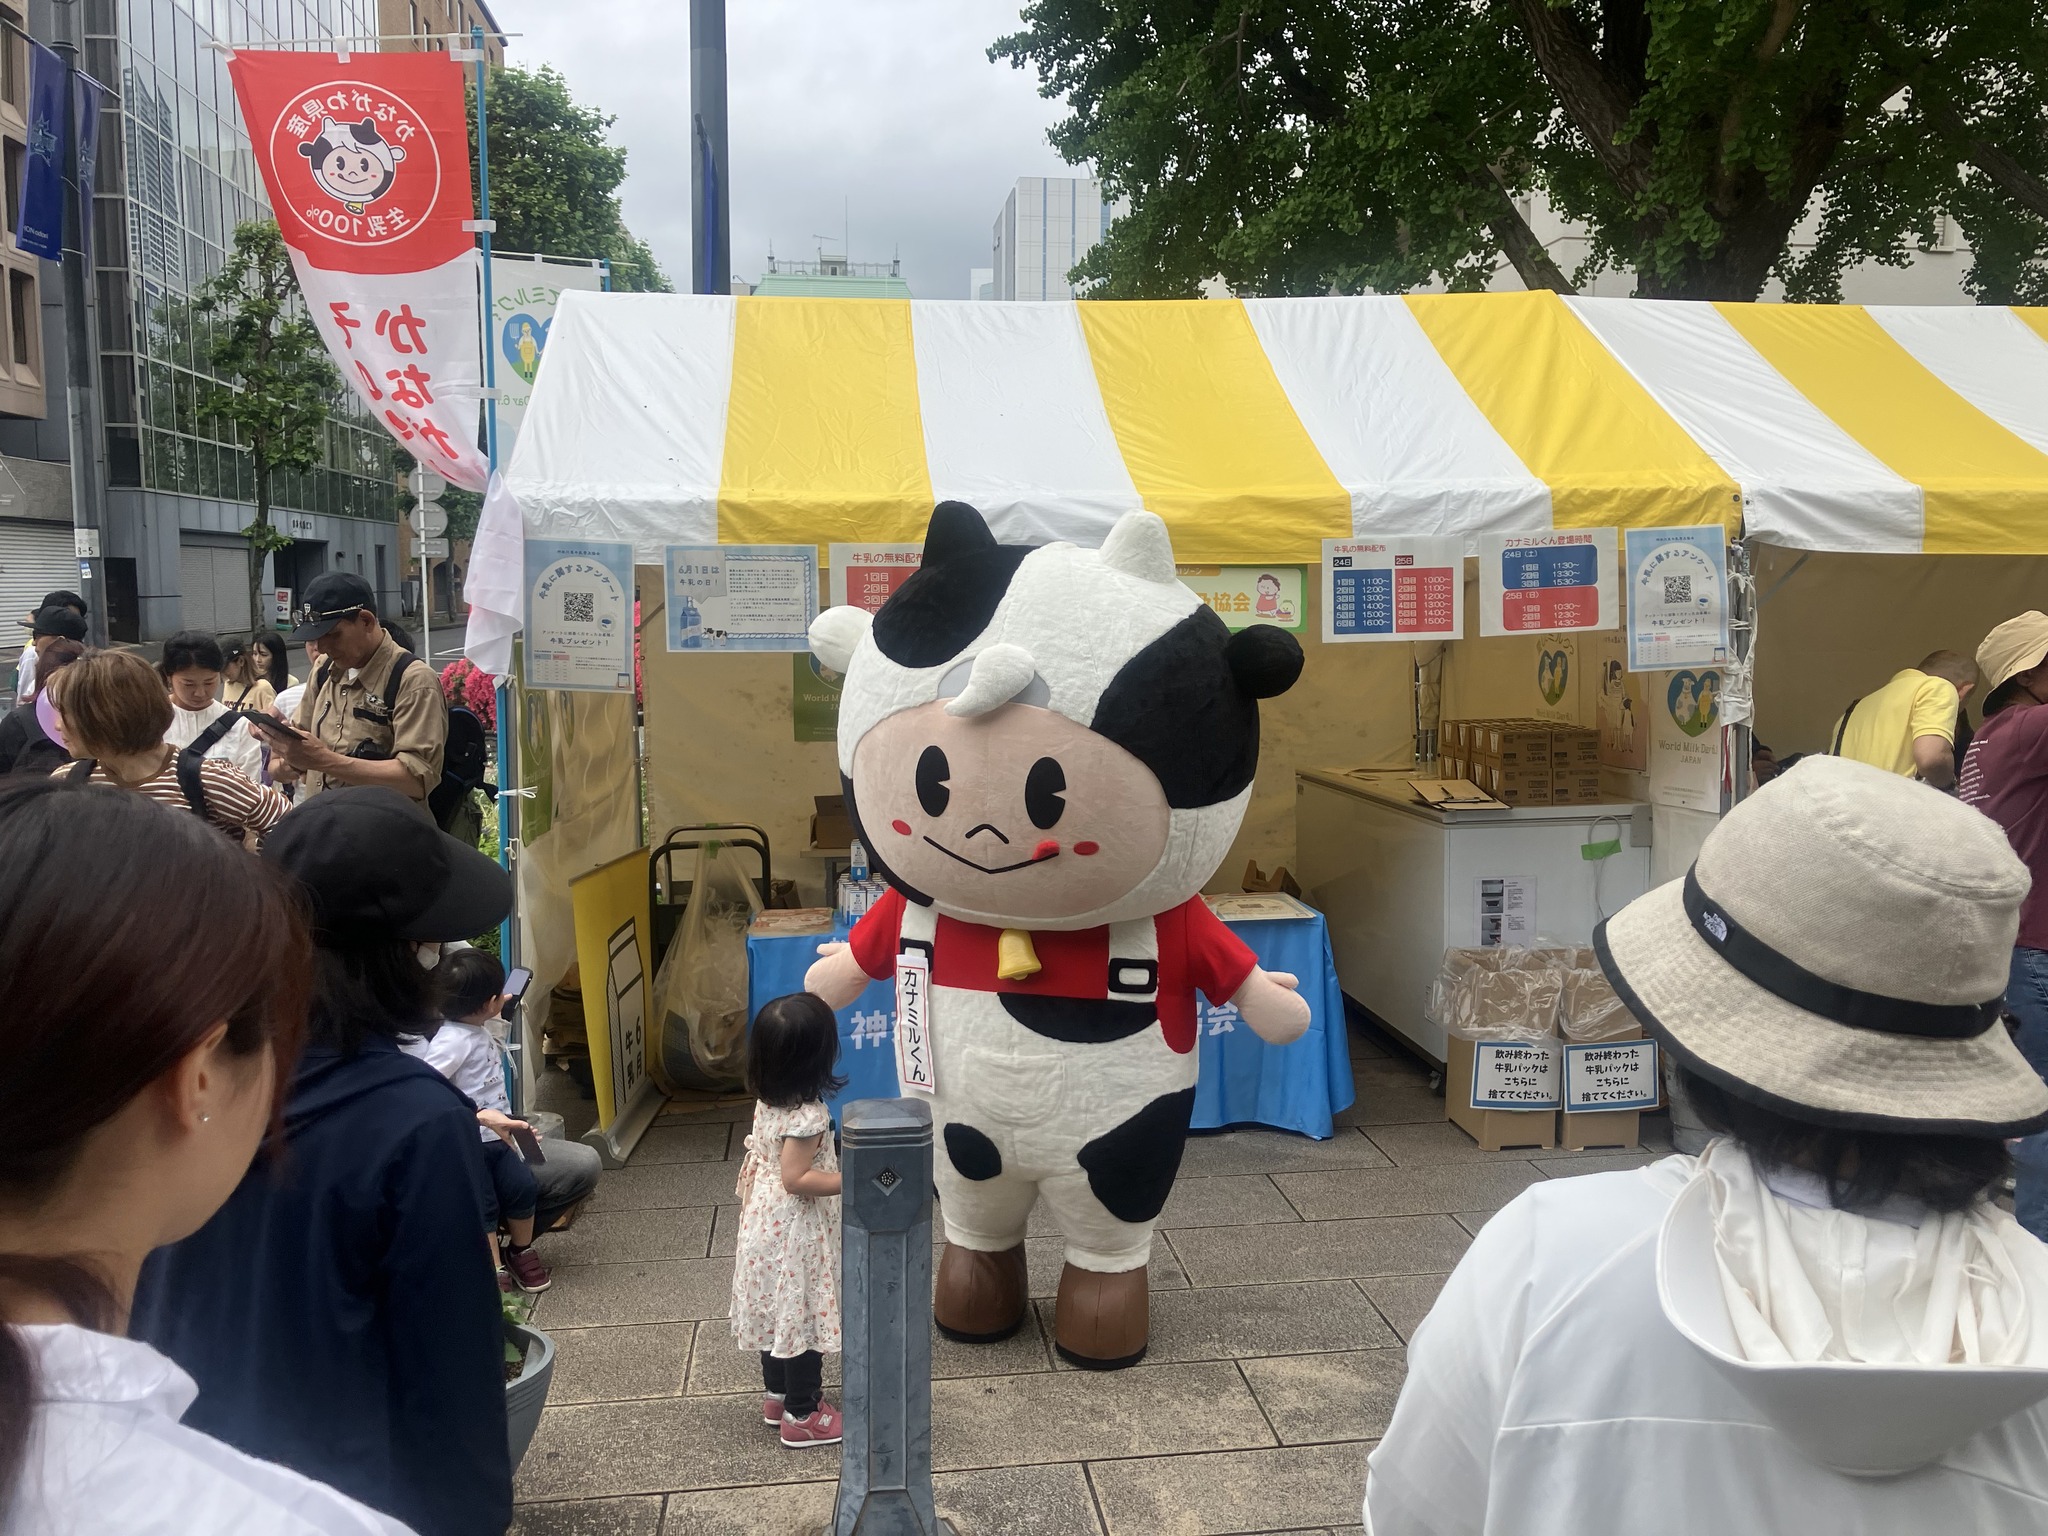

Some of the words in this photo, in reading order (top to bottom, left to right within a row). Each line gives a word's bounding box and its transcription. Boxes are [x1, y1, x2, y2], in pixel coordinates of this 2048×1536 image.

[1505, 534, 1593, 547] カナミルくん登場時間
[1333, 544, 1386, 553] 牛乳の無料配布
[1333, 558, 1352, 566] 24日
[1395, 557, 1413, 565] 25日
[678, 565, 720, 574] 6月1日は
[1521, 563, 1539, 571] 1回目
[1641, 549, 1714, 586] 牛乳に関するアンケート
[864, 572, 889, 582] 1回目
[1521, 571, 1539, 579] 2回目
[538, 564, 619, 601] 牛乳に関するアンケート
[1336, 578, 1355, 586] 1回目
[1398, 576, 1416, 584] 1回目
[863, 584, 889, 593] 2回目
[1336, 586, 1355, 594] 2回目
[1522, 604, 1540, 612] 1回目
[1522, 612, 1540, 620] 2回目
[1398, 618, 1416, 626] 6回目
[1522, 620, 1540, 628] 3回目
[803, 694, 829, 702] World
[1659, 740, 1681, 751] World
[1683, 742, 1699, 752] Milk
[1680, 755, 1702, 764] JAPAN
[904, 969, 926, 1083] カナミルくん
[1495, 1049, 1550, 1060] 飲み終わった
[1584, 1049, 1640, 1062] 飲み終わった
[1494, 1063, 1549, 1074] 牛乳パックは
[1585, 1062, 1640, 1075] 牛乳パックは
[1504, 1076, 1538, 1086] こちらに
[1596, 1076, 1630, 1087] こちらに
[1488, 1089, 1553, 1100] 捨ててください。
[1581, 1090, 1648, 1102] 捨ててください。
